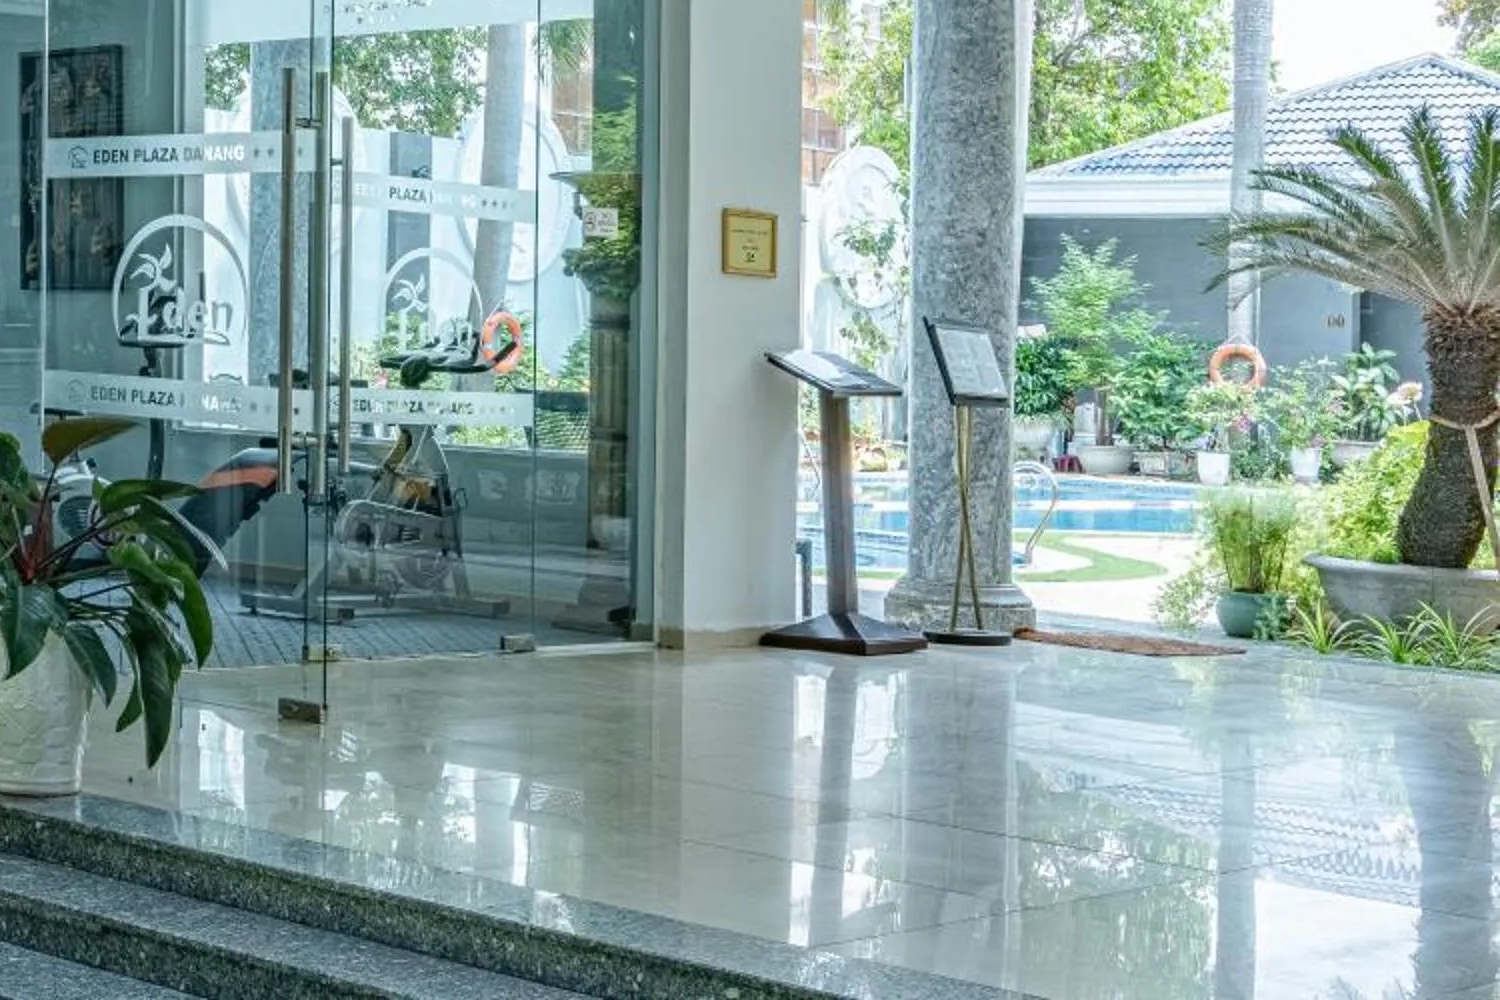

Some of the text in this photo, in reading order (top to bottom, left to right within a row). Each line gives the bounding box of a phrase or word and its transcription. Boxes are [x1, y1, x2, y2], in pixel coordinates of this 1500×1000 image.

[93, 144, 246, 164] EDEN PLAZA DANANG
[389, 186, 427, 204] PLAZA
[91, 385, 127, 402] EDEN
[131, 389, 175, 407] PLAZA
